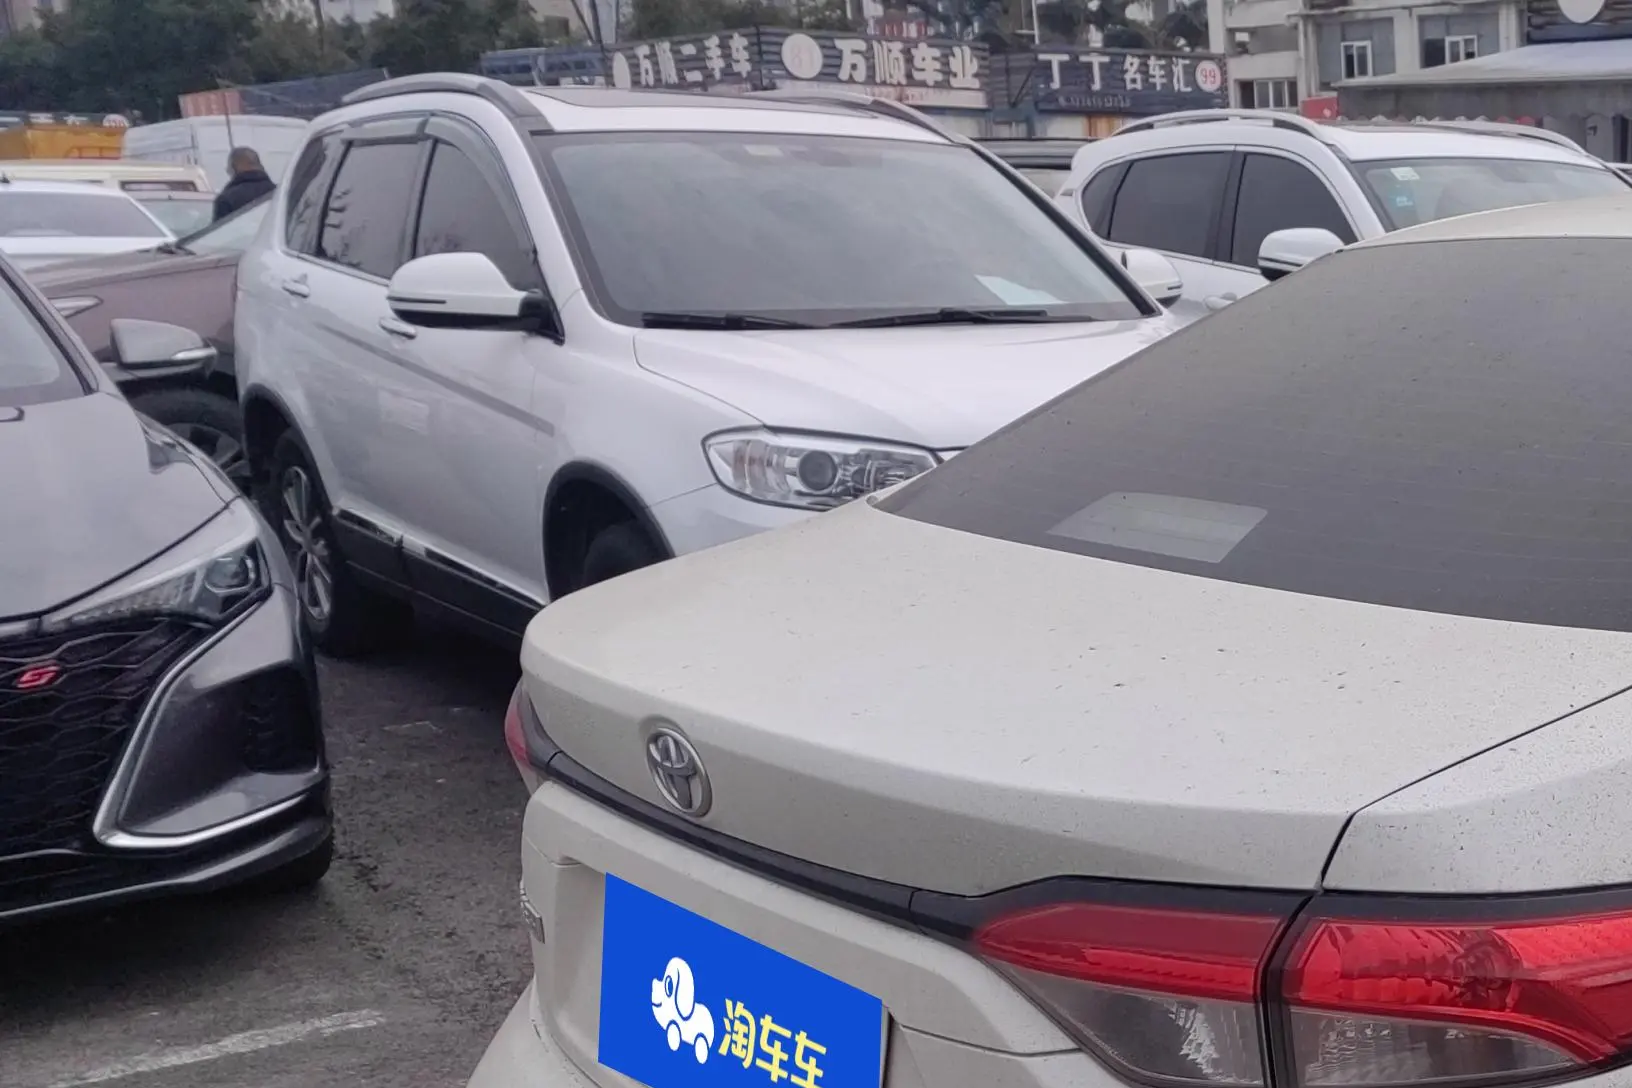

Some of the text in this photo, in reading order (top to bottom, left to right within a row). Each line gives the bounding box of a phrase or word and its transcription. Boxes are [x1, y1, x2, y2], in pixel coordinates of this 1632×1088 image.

[634, 31, 752, 87] 万顺二手车
[834, 38, 981, 89] 万顺车业
